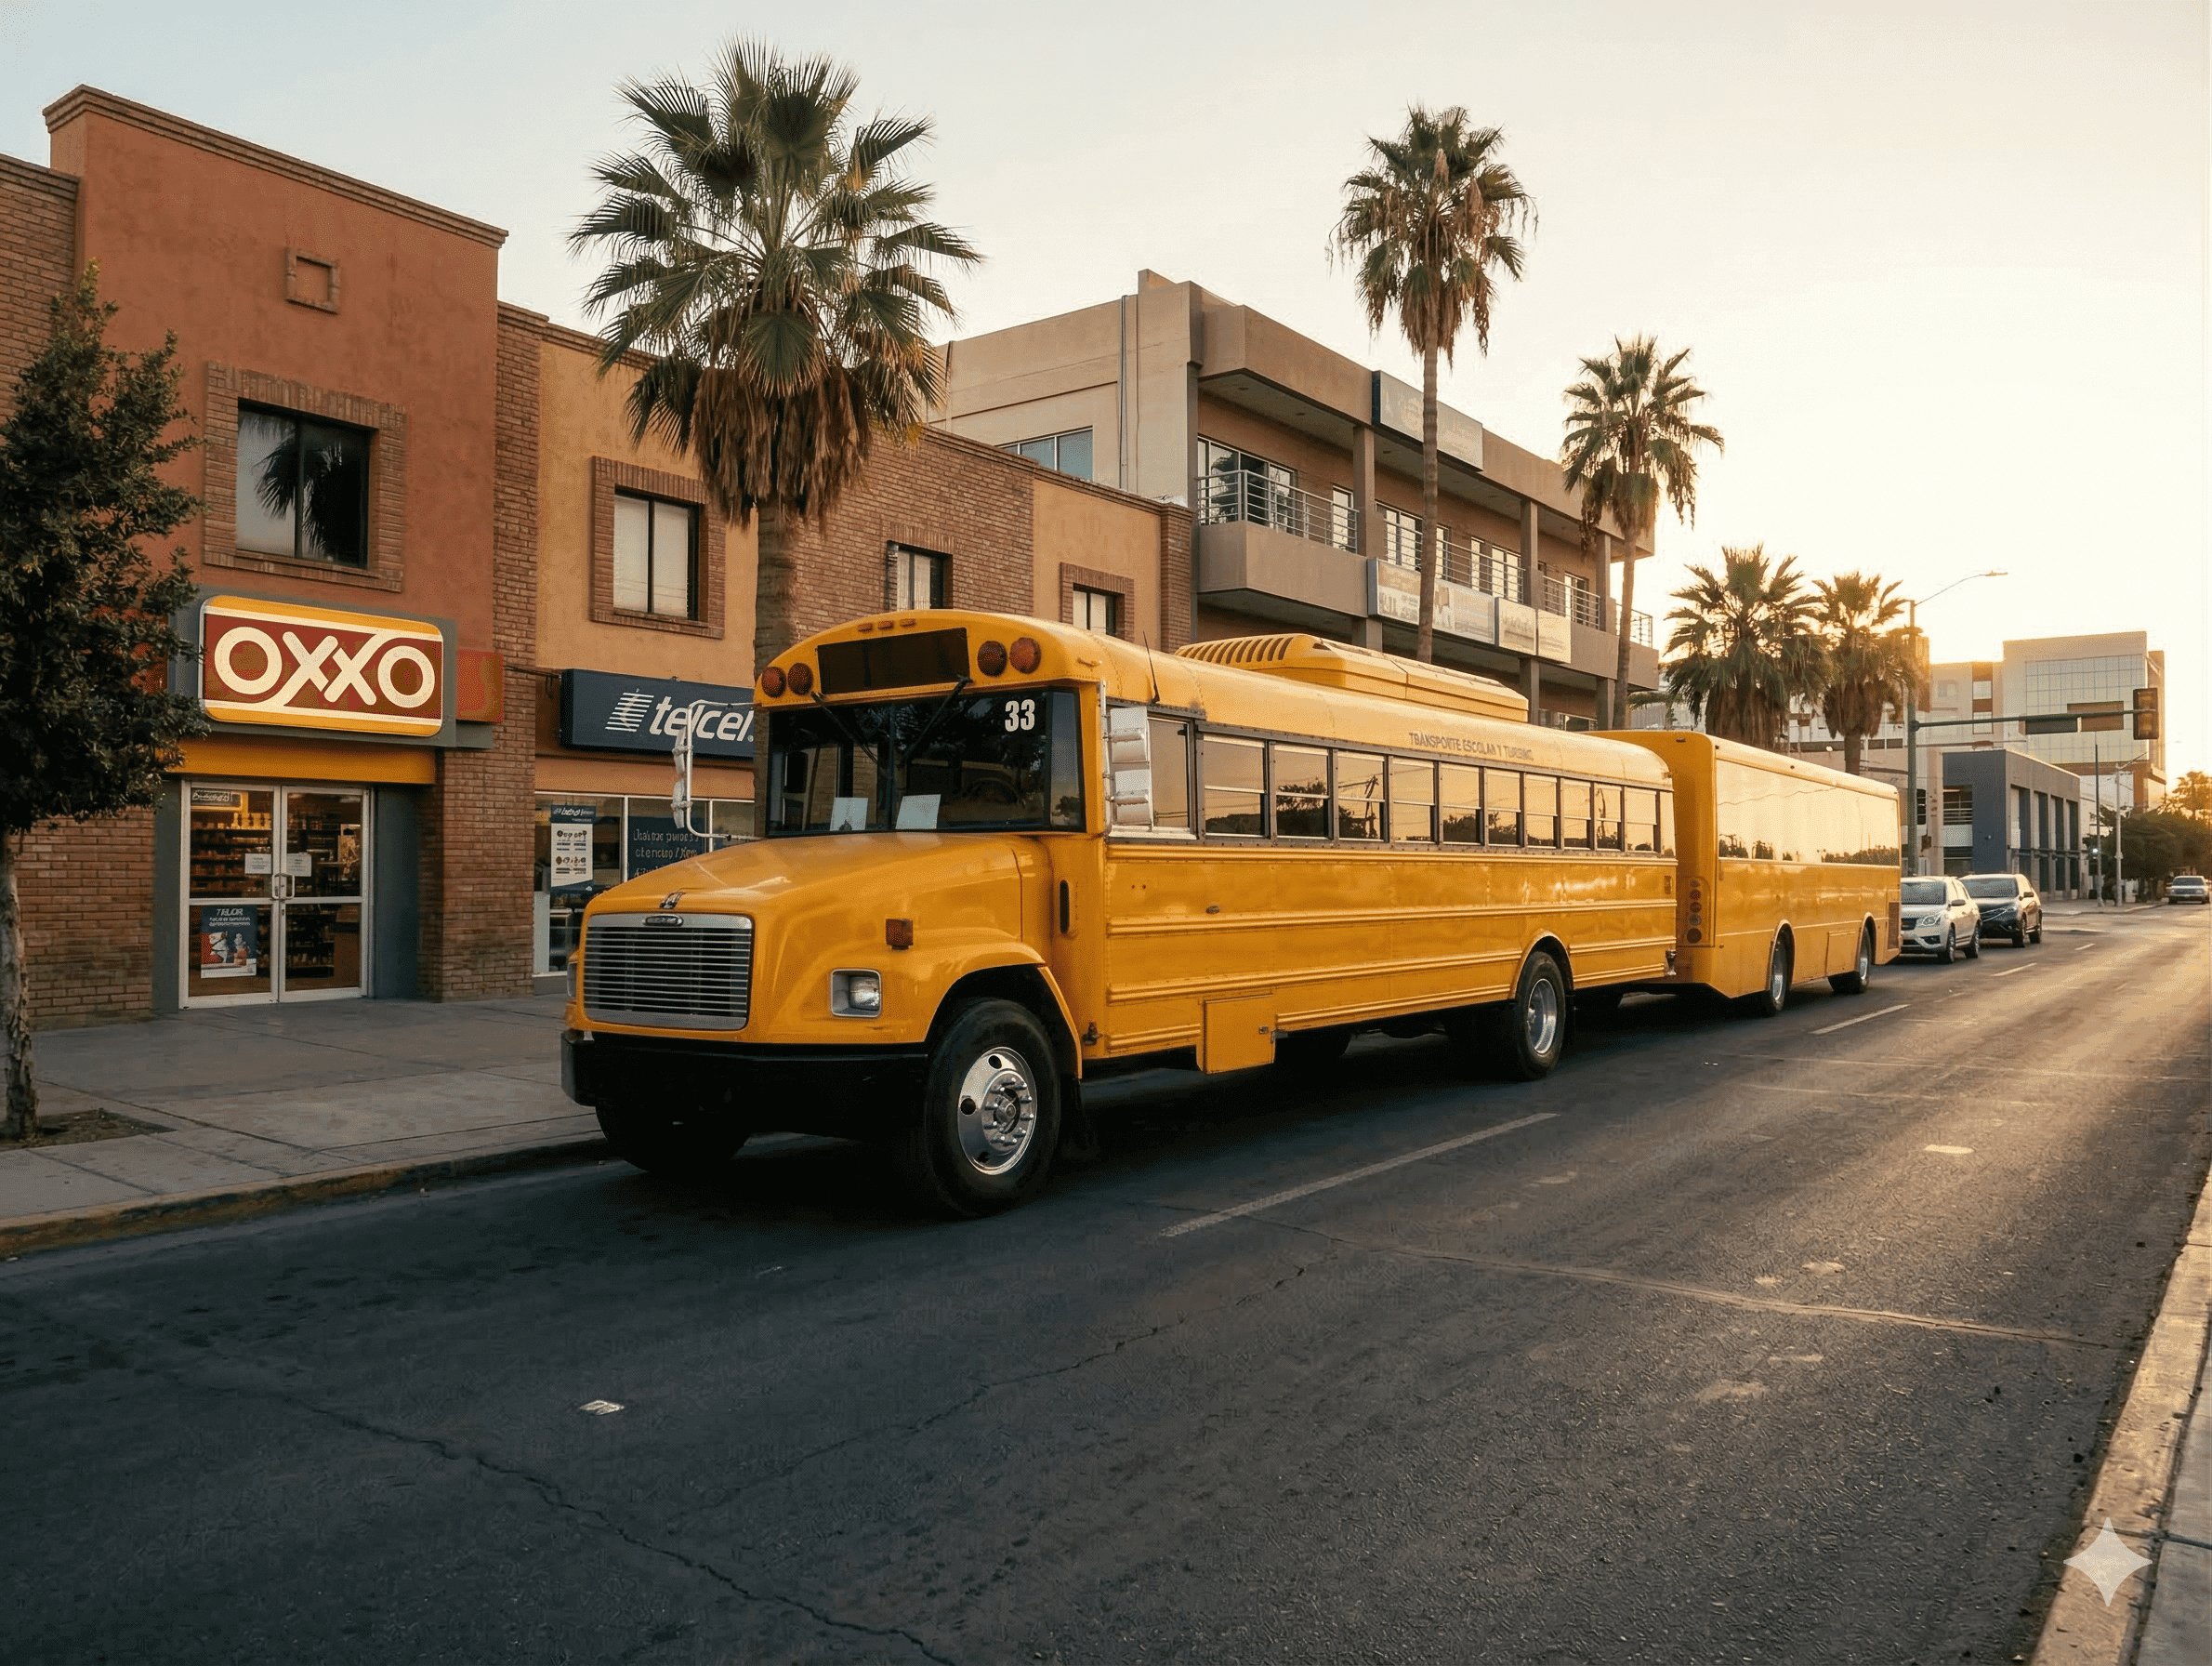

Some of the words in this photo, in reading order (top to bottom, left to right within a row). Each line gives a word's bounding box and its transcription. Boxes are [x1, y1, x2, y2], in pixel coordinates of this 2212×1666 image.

[214, 626, 436, 708] OXXO
[649, 695, 755, 742] telcel
[1005, 698, 1035, 732] 33
